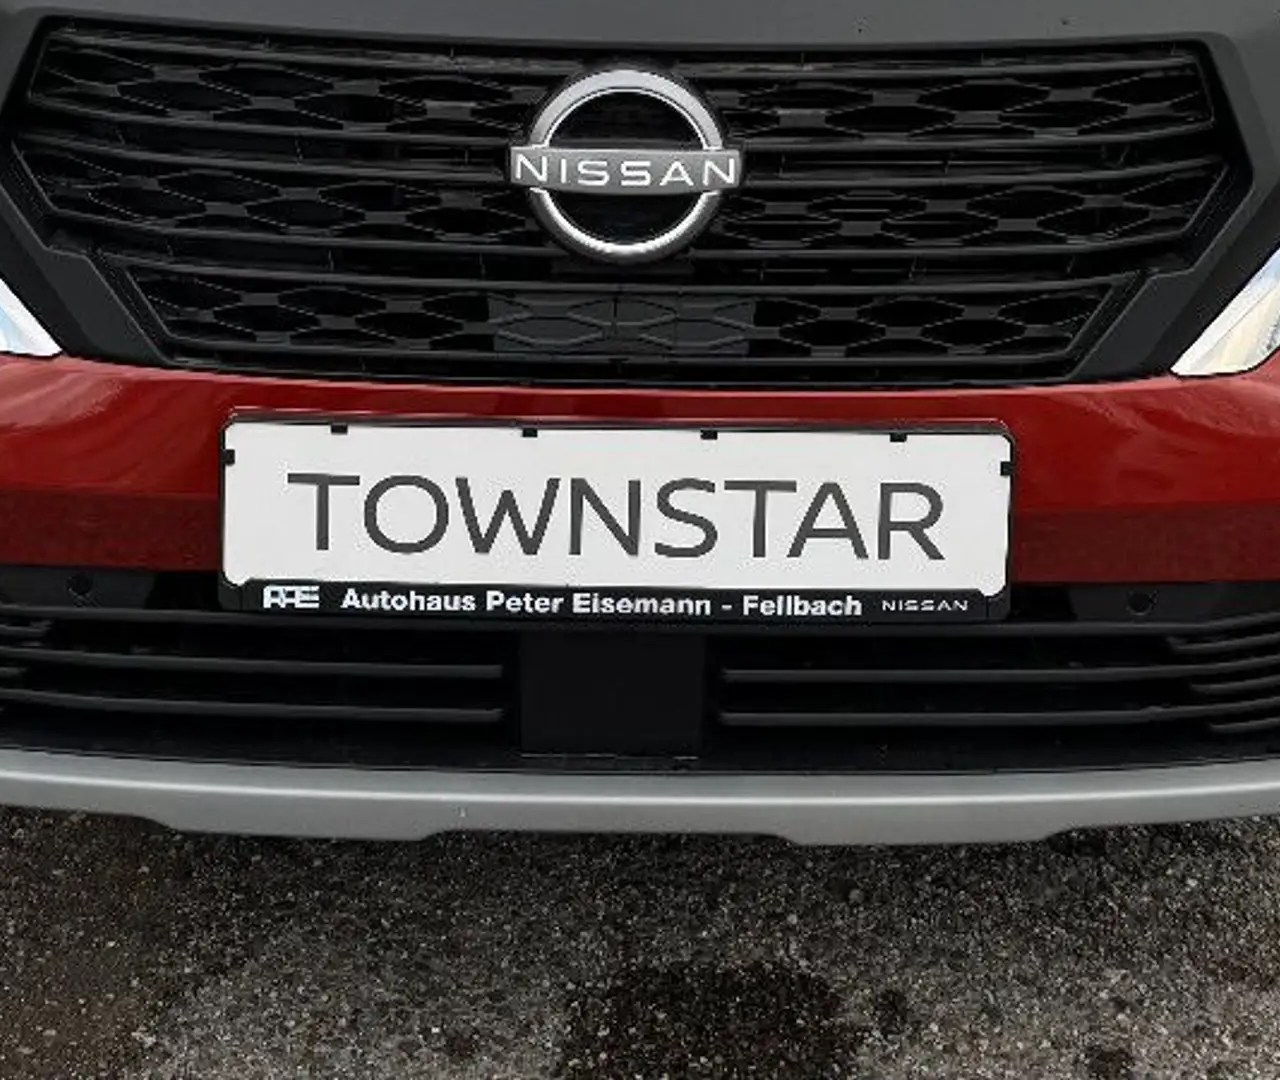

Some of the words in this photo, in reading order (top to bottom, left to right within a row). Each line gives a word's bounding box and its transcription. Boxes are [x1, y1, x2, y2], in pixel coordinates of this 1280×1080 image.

[515, 153, 735, 186] NISSAN
[287, 473, 945, 561] TOWNSTAR
[341, 588, 476, 612] Autohaus
[486, 591, 564, 614] Peter
[573, 592, 711, 617] Eisemann
[743, 594, 863, 617] Fellbach
[882, 599, 968, 612] NISSAN
